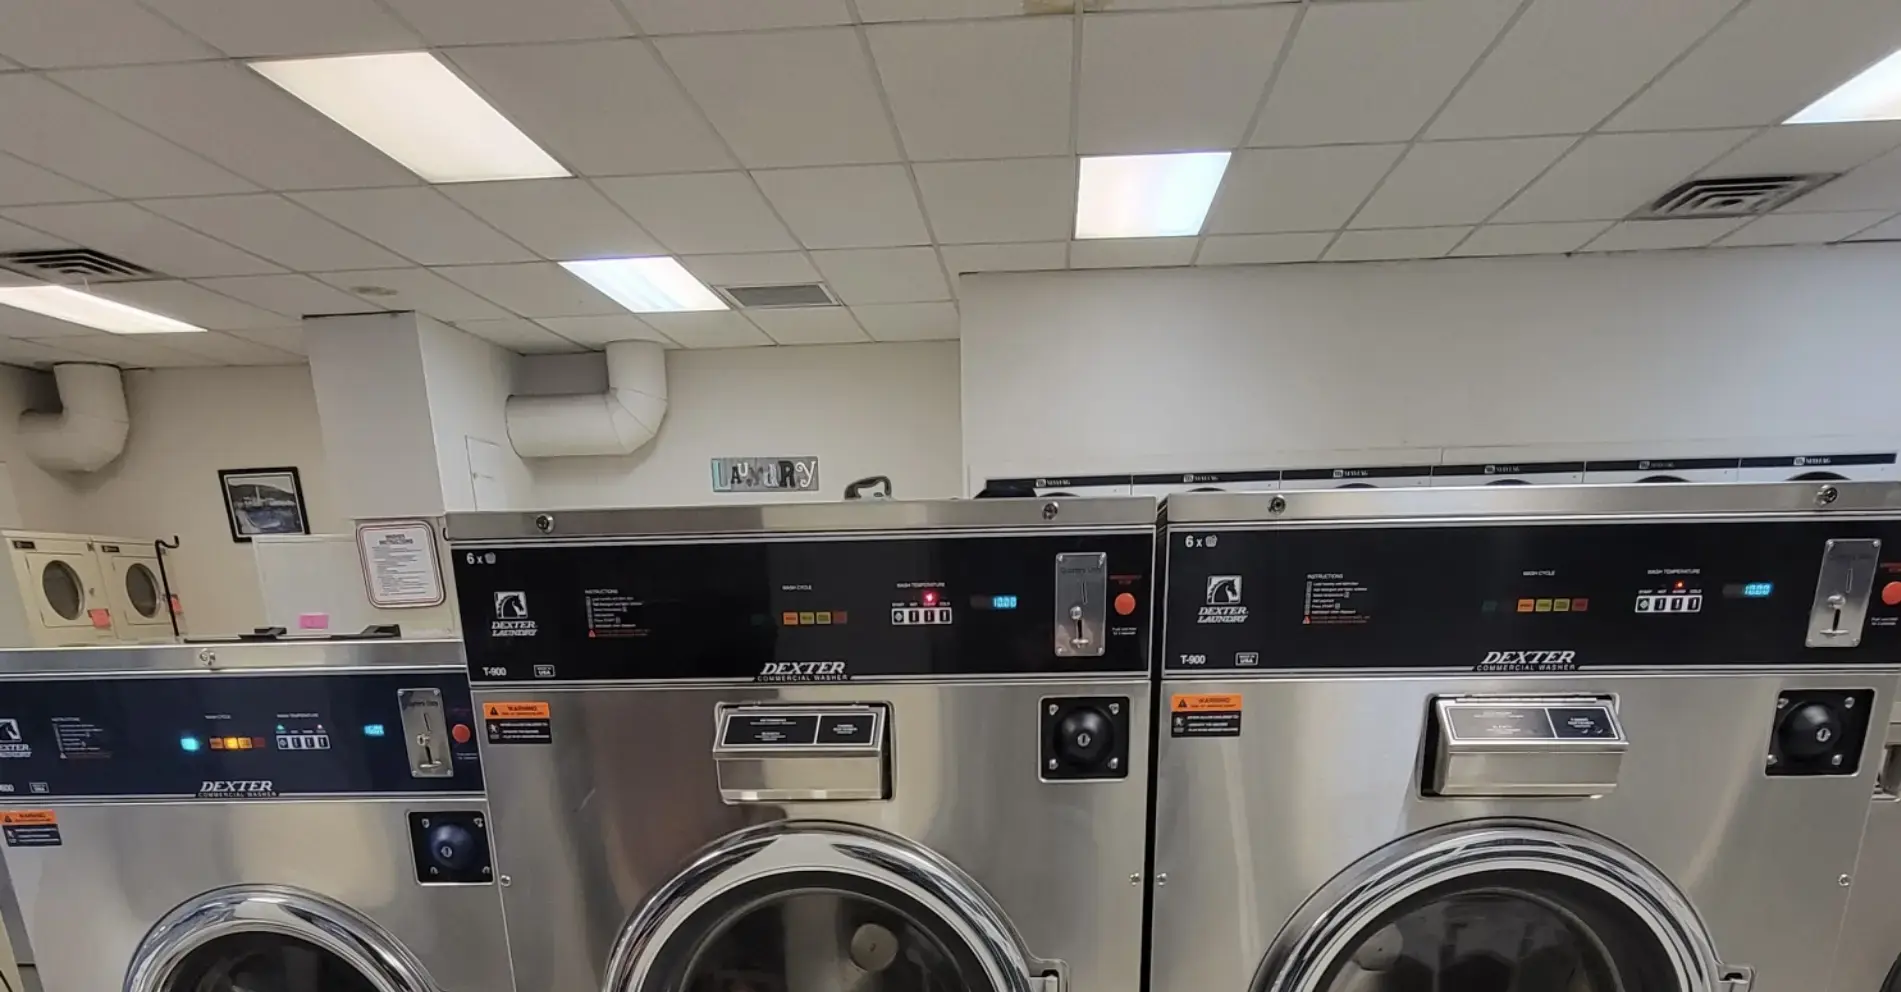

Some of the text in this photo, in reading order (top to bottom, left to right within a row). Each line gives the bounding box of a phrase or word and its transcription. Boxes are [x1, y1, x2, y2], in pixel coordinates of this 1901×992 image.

[1185, 535, 1203, 548] 6 x
[466, 552, 483, 565] 6 x
[1198, 606, 1248, 615] DEXTER
[491, 620, 536, 629] DEXTER
[1197, 615, 1248, 623] LAUNDRY
[1180, 654, 1206, 665] T-900
[1481, 650, 1576, 664] DEXTER
[482, 666, 507, 676] T-900
[760, 661, 846, 675] DEXTER
[1538, 663, 1576, 671] WASHER
[200, 780, 273, 792] DEXTER
